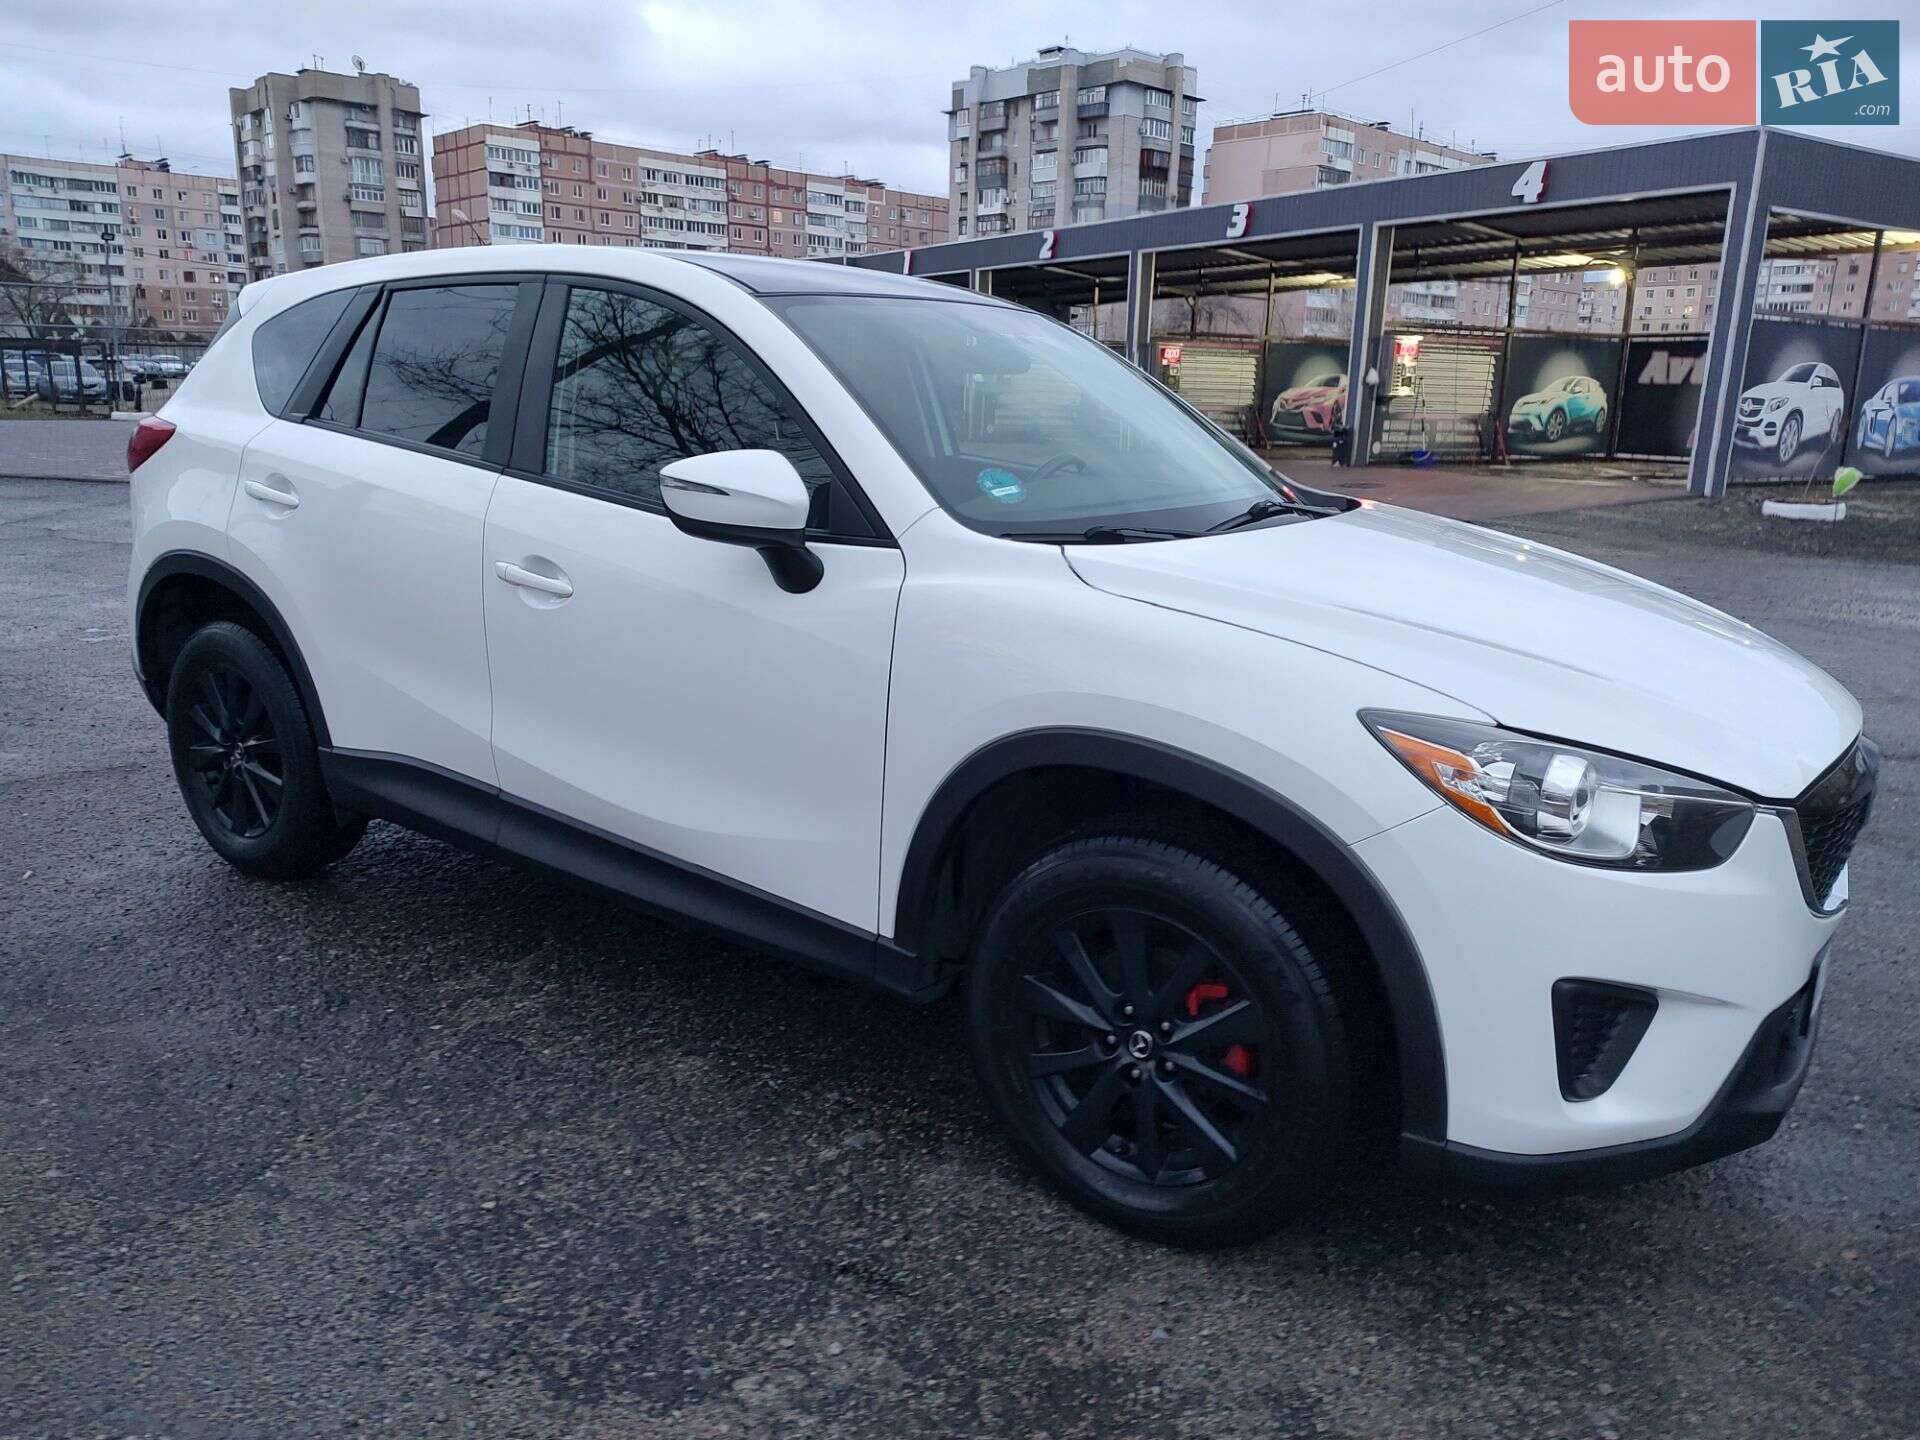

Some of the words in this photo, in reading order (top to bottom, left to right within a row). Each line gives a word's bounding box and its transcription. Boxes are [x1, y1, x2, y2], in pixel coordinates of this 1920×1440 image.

[1511, 160, 1549, 203] 4
[1226, 203, 1251, 238] 3
[1039, 229, 1056, 259] 2
